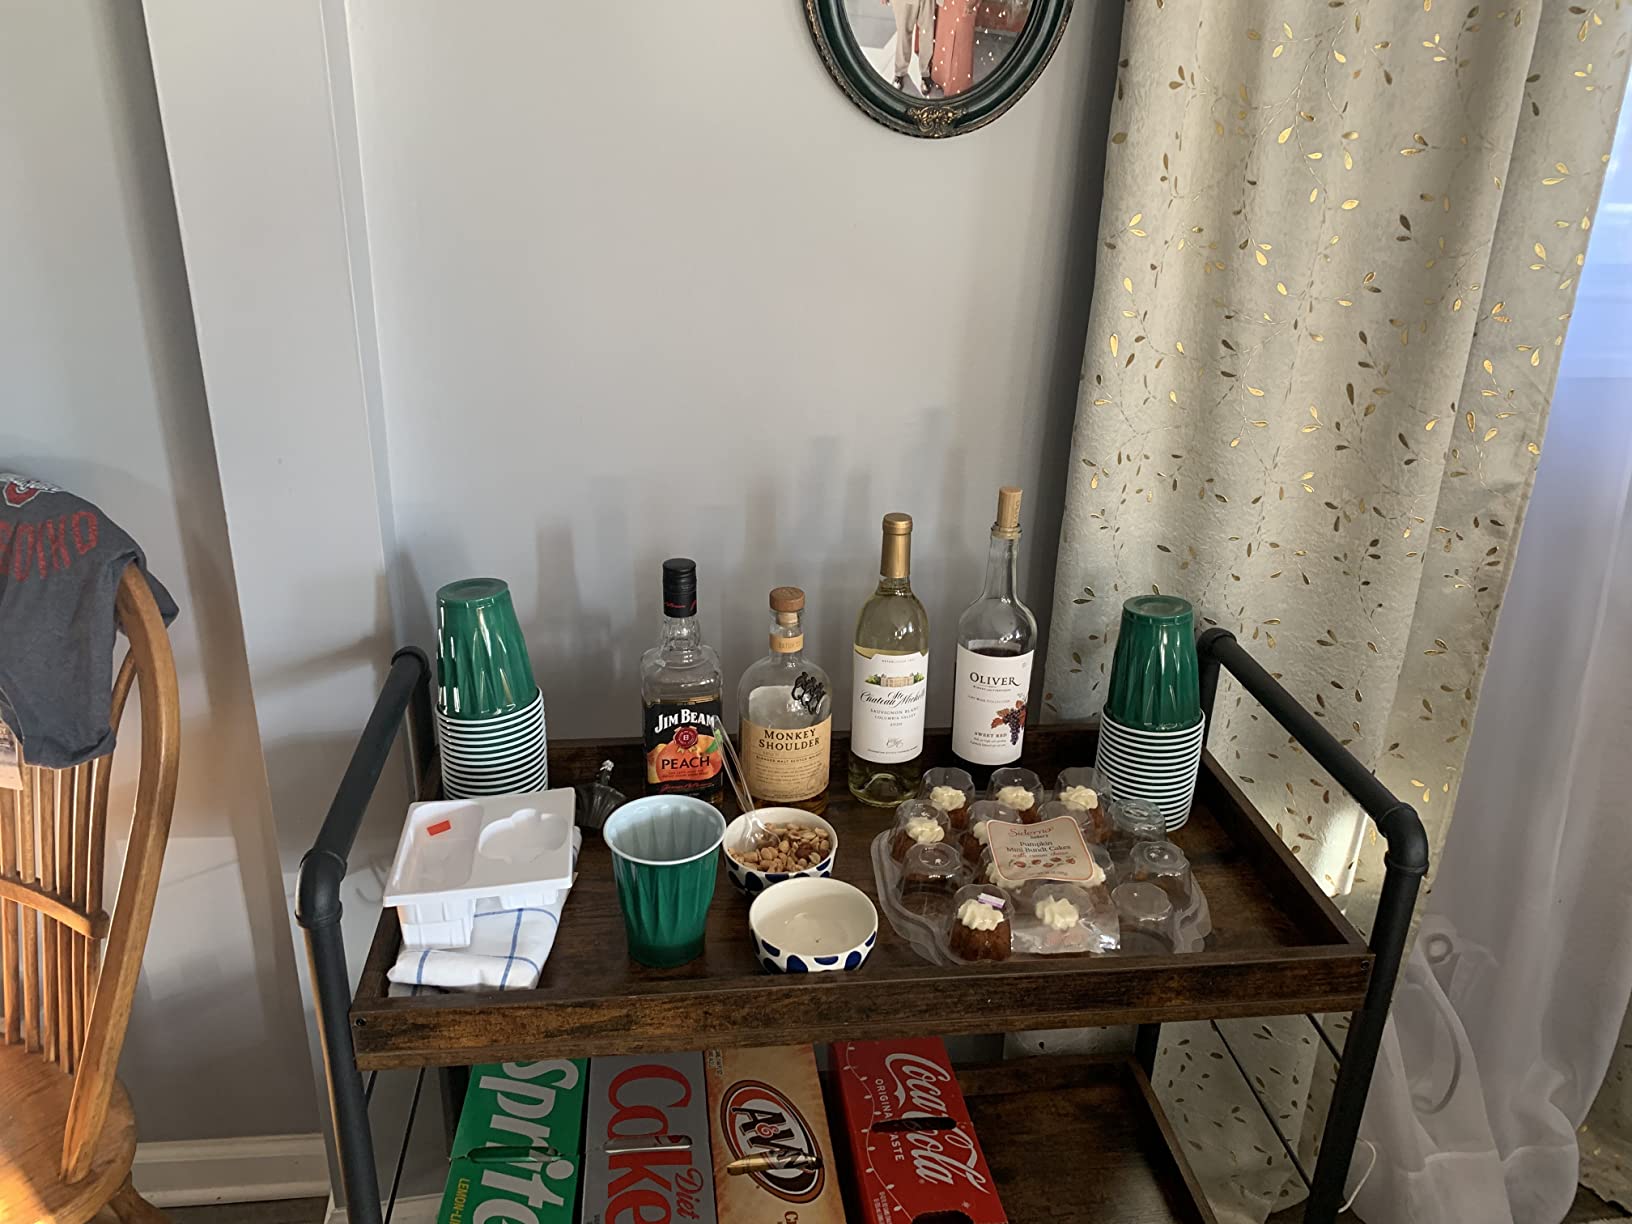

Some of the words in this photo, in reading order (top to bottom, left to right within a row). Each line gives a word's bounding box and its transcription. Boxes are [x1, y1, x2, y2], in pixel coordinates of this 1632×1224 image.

[969, 672, 1021, 687] OLIVER
[654, 713, 679, 734] JIM
[680, 708, 715, 728] BEAM
[764, 728, 816, 740] MONKEY
[758, 737, 820, 751] SHOULDER
[661, 755, 710, 770] PEACH
[874, 1078, 893, 1120] ORIGINA
[888, 1131, 905, 1162] ASTE
[473, 1058, 579, 1224] Sprite
[605, 1064, 692, 1224] Coke
[674, 1167, 704, 1221] Diet
